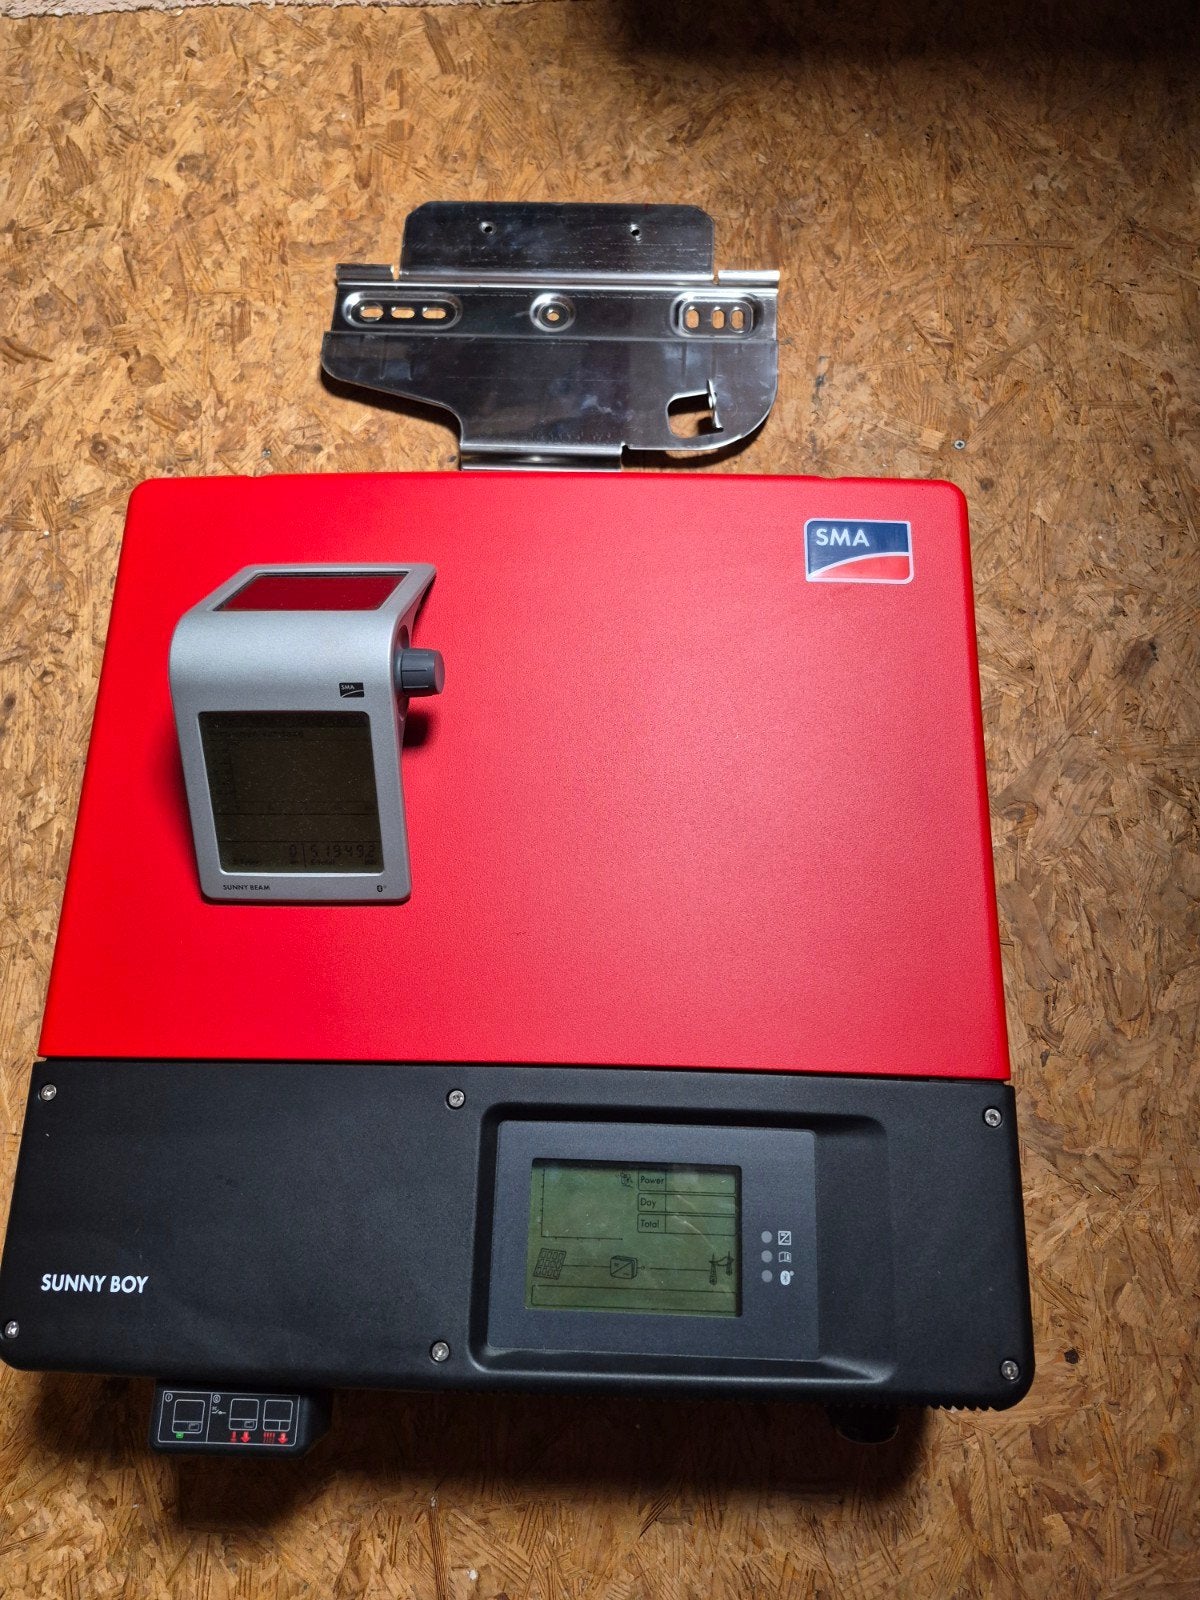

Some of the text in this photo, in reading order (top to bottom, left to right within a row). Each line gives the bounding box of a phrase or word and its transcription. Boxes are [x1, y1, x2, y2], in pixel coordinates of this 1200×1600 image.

[816, 528, 870, 547] SMA
[640, 1175, 665, 1185] Power
[640, 1197, 656, 1208] Day
[641, 1219, 660, 1229] Total
[40, 1273, 149, 1294] SUNNY BOY
